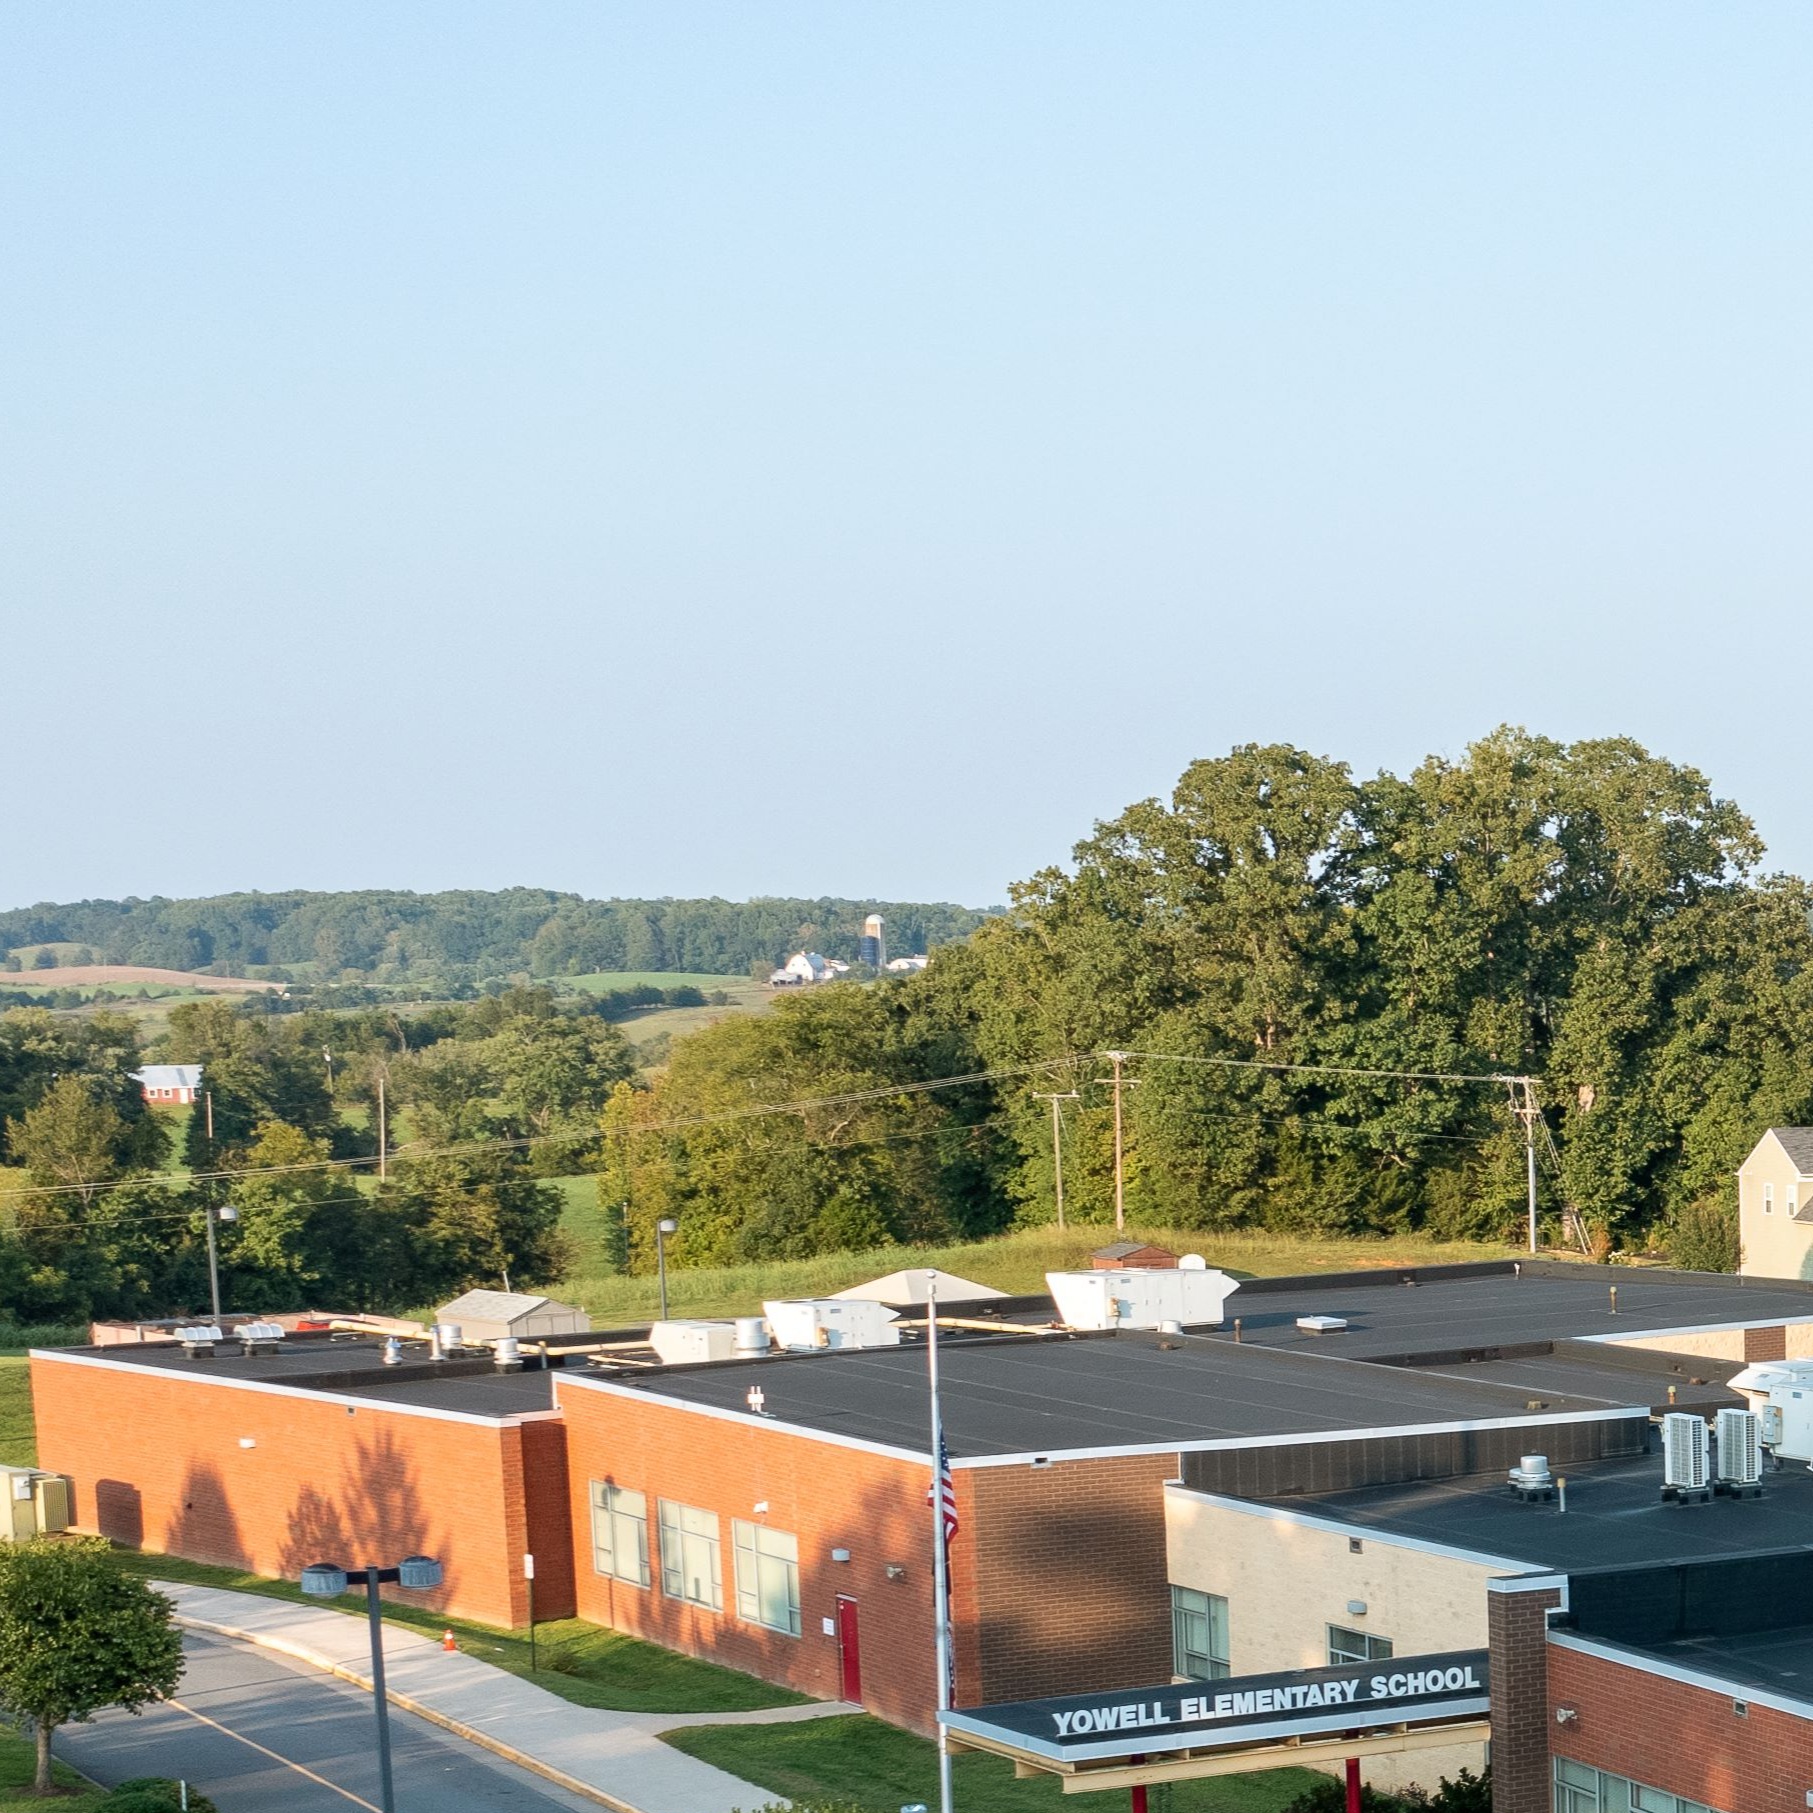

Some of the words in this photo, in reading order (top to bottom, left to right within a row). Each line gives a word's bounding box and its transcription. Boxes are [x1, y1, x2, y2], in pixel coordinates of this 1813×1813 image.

[1052, 1702, 1170, 1735] YOWELL
[1181, 1679, 1360, 1720] ELEMENTARY
[1370, 1666, 1480, 1698] SCHOOL
